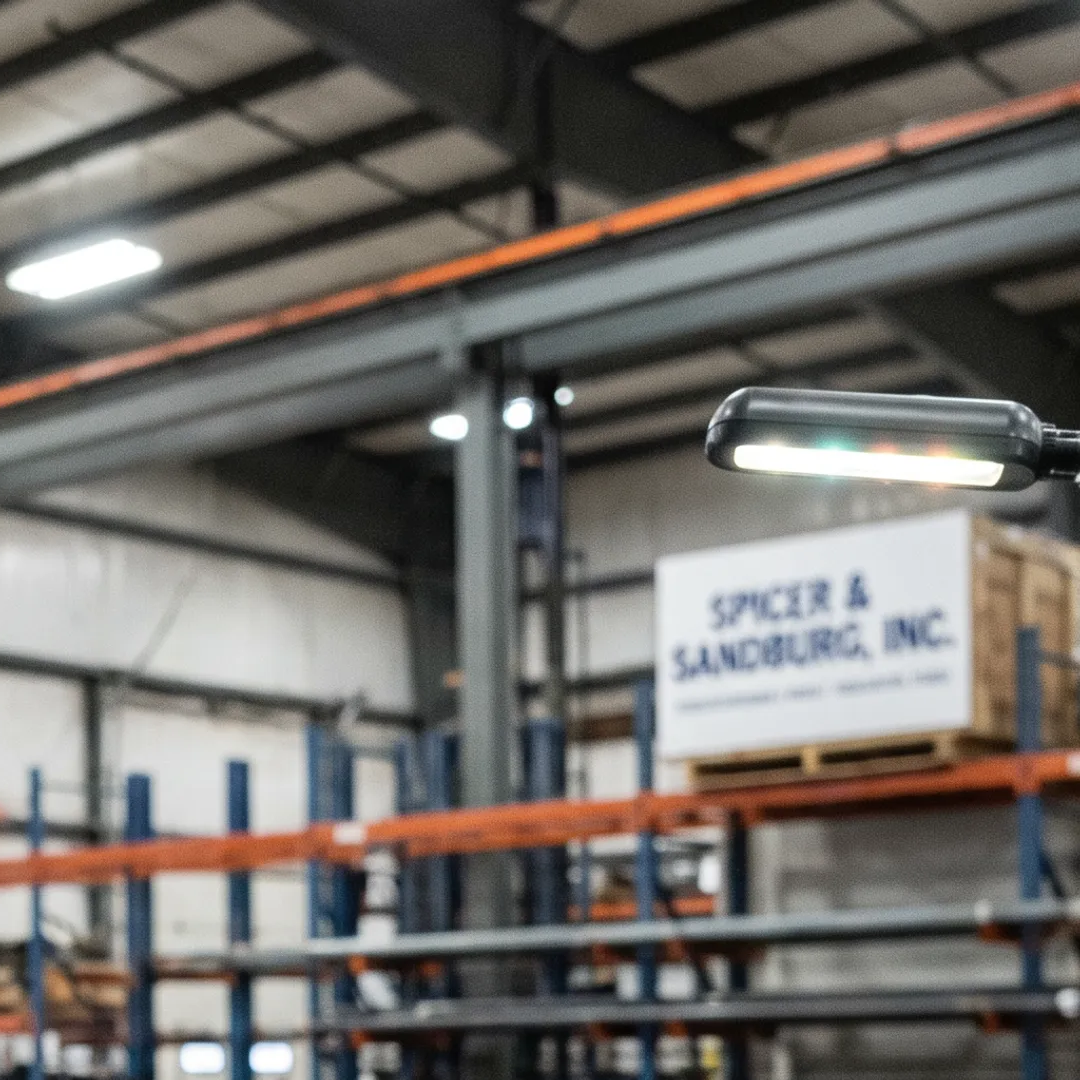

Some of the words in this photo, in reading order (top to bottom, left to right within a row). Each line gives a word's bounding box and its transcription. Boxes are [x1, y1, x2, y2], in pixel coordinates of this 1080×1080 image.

[710, 578, 831, 630] SPICER
[847, 573, 870, 609] &
[672, 623, 871, 682] SANDBURG,
[883, 610, 954, 653] INC.
